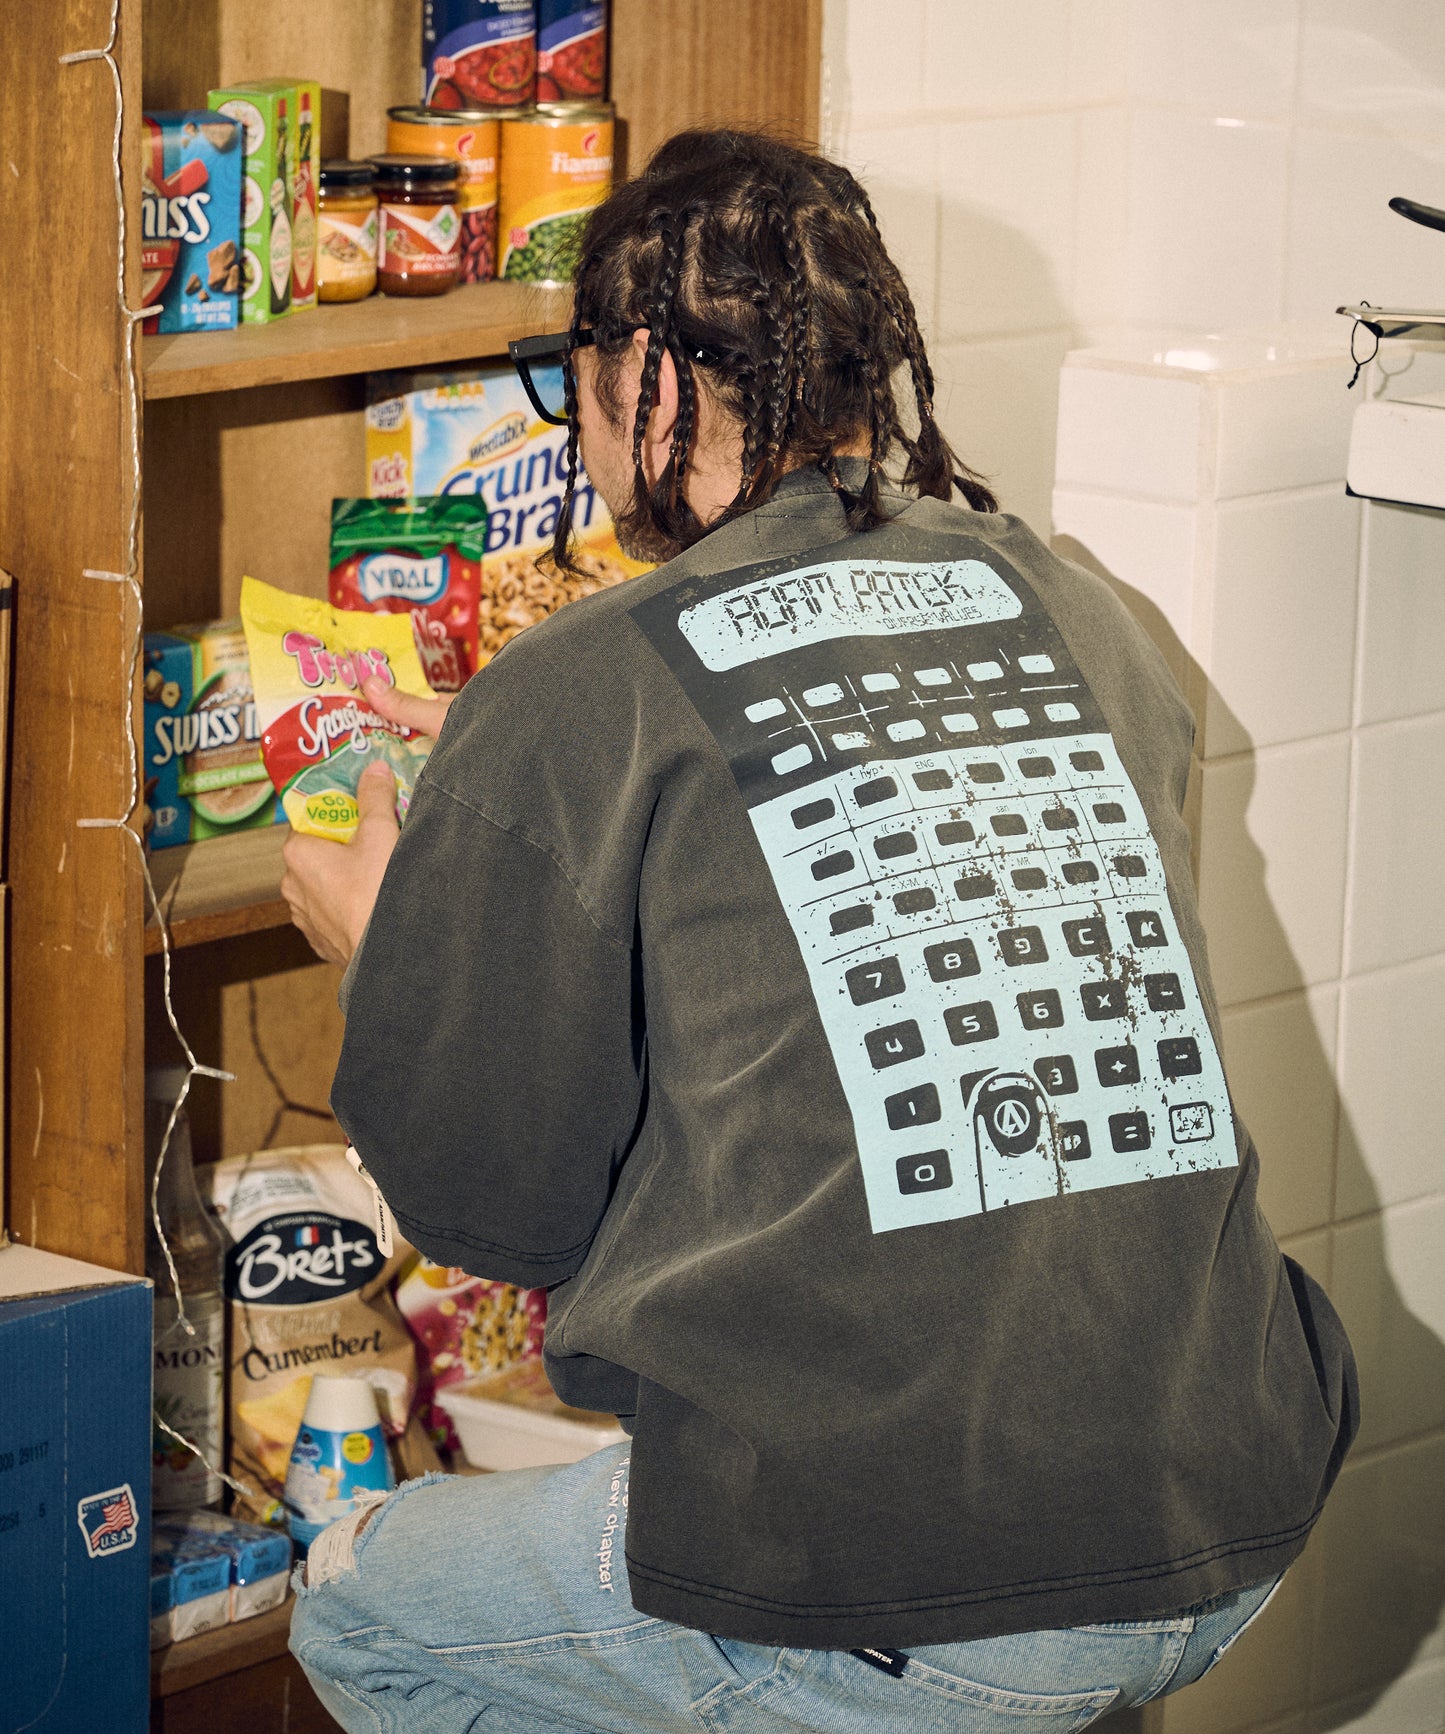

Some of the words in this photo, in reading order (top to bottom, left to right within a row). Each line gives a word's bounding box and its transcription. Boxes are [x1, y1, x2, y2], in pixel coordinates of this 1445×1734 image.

[469, 421, 526, 460] Weetabix
[440, 438, 586, 502] Crunc
[484, 485, 594, 553] Bran
[369, 565, 435, 588] VIDAL
[724, 572, 844, 638] ADAM
[850, 570, 974, 614] PATEK
[935, 605, 982, 624] VALUES
[152, 706, 240, 765] SWISS
[859, 767, 879, 779] hyp
[914, 759, 934, 770] ENG
[322, 795, 346, 806] Go
[1016, 856, 1031, 867] MR
[1077, 927, 1095, 945] C
[1014, 937, 1031, 955] 9
[943, 952, 962, 970] 8
[865, 971, 882, 989] 7
[1033, 1002, 1050, 1019] 6
[961, 1015, 981, 1033] 5
[1051, 1067, 1064, 1086] 3
[1182, 1117, 1206, 1131] EXE
[914, 1164, 935, 1182] 0
[236, 1229, 374, 1299] Brets
[243, 1329, 381, 1381] Camembert
[608, 1469, 625, 1508] new
[597, 1513, 619, 1593] chapter
